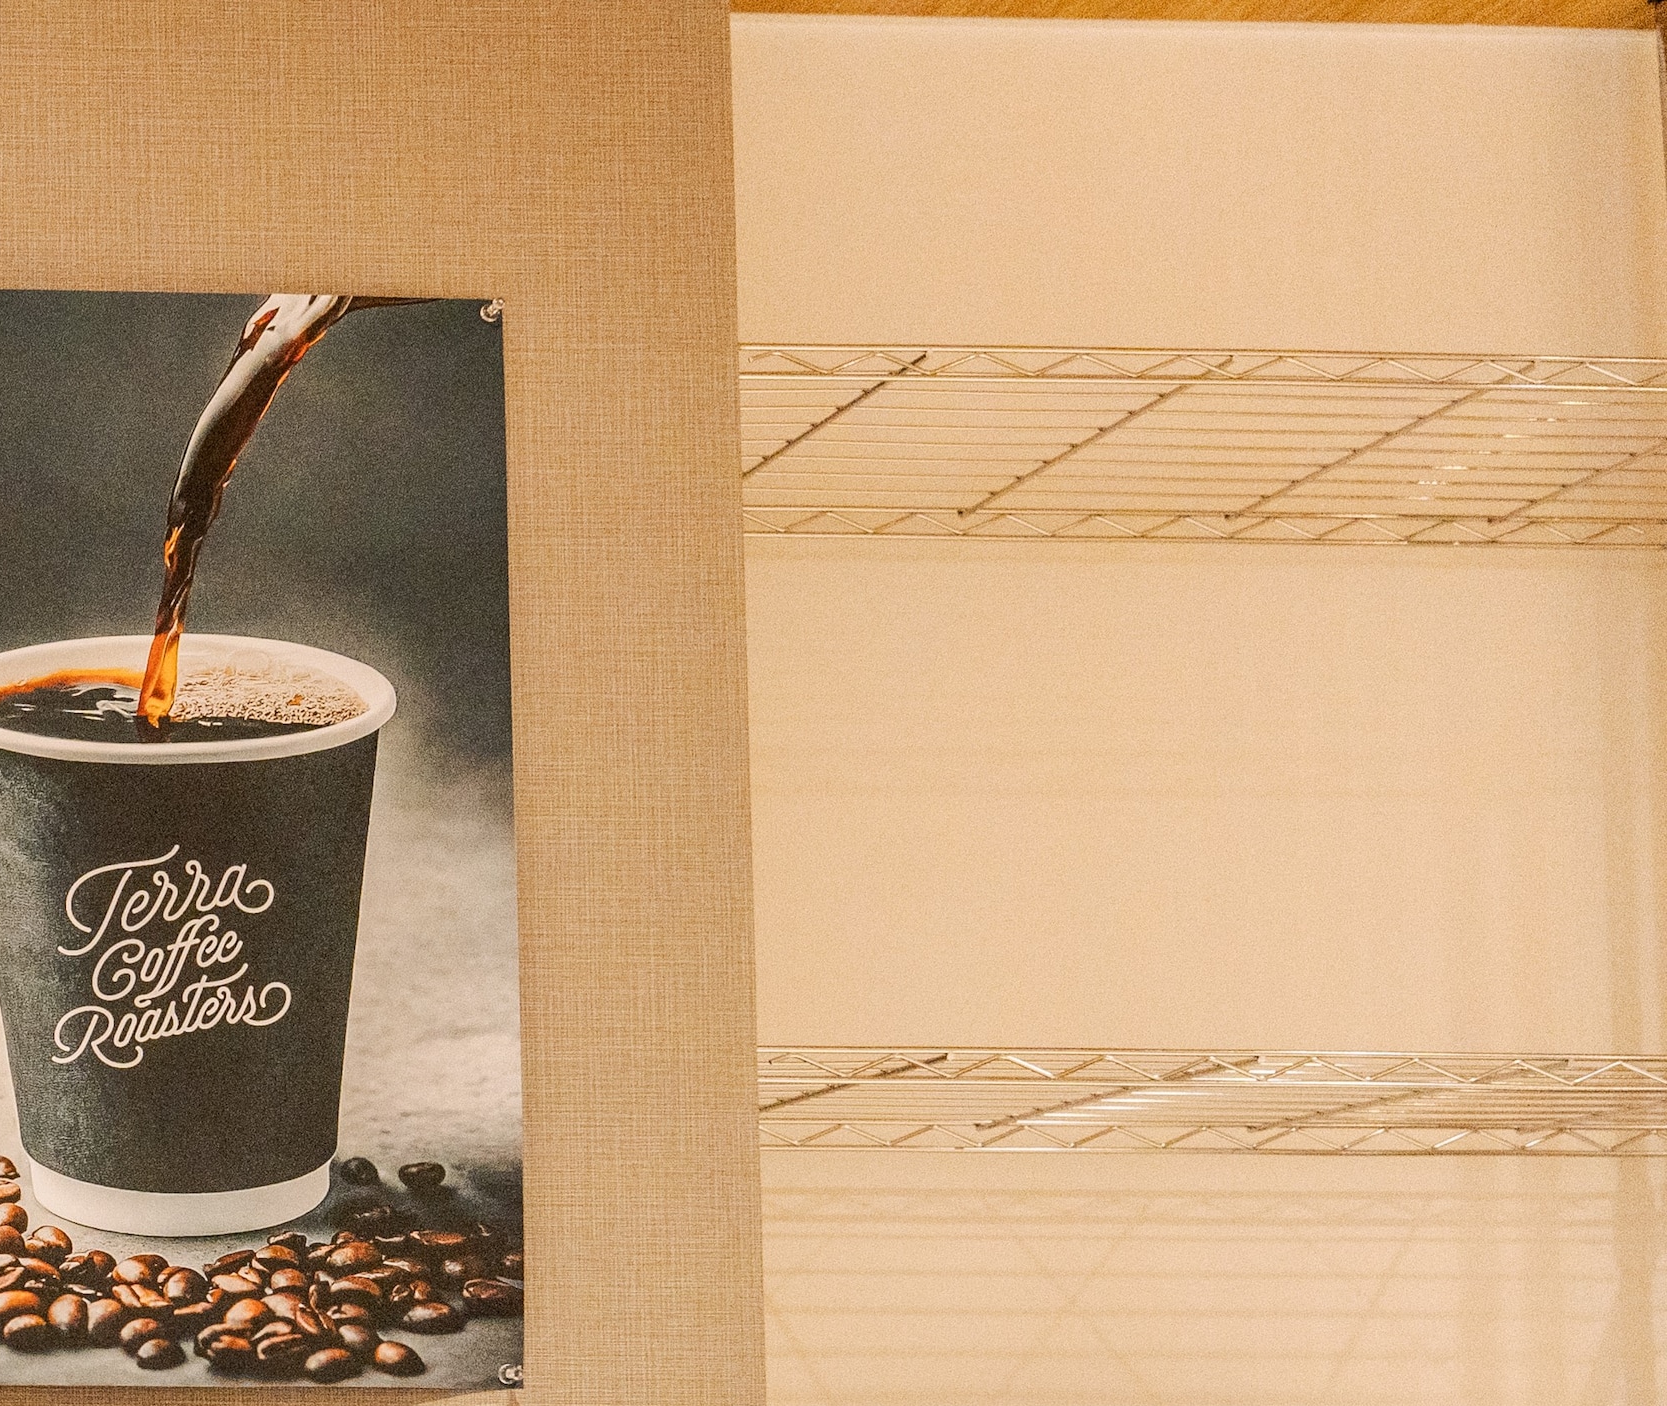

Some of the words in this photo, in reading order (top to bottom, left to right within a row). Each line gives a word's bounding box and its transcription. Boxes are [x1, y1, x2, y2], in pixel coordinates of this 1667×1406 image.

[57, 844, 275, 956] Terra
[92, 913, 245, 1008] Coffee
[51, 963, 292, 1069] Roasters
